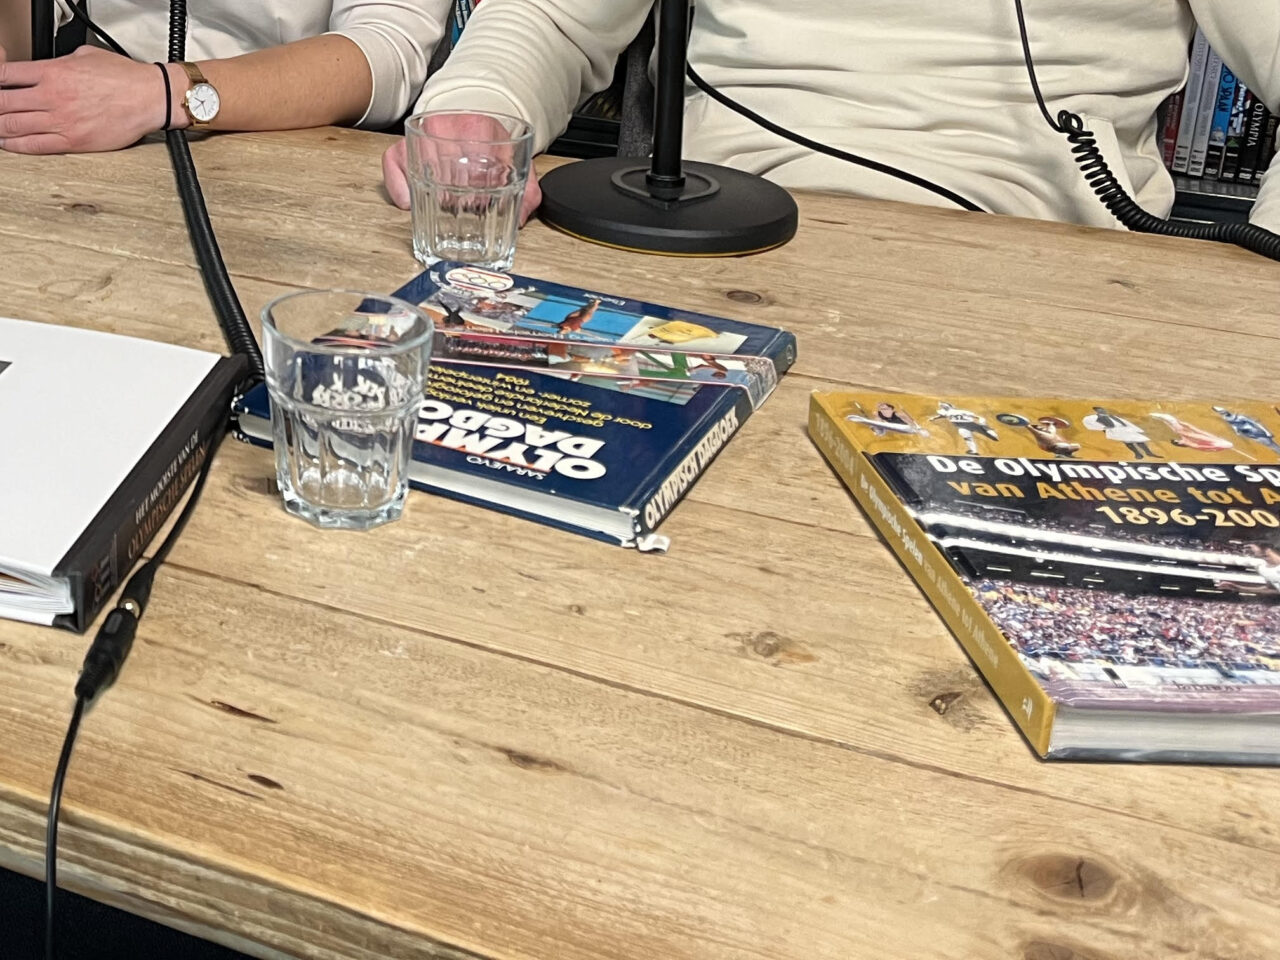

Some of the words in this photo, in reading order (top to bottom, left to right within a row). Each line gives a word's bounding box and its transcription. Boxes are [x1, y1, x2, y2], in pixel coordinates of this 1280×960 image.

[1247, 102, 1265, 146] OLYMPIA
[495, 372, 531, 386] 1984
[476, 401, 517, 418] uniek
[493, 388, 590, 417] Nederlandse
[494, 397, 515, 408] en
[516, 402, 605, 428] geschreven
[519, 413, 548, 425] Een
[590, 412, 614, 423] de
[615, 417, 653, 430] door
[467, 455, 547, 480] SARAJEVO
[644, 456, 700, 529] OLYMPISCH
[699, 405, 740, 468] DAGBOEK
[947, 480, 1023, 498] van
[1037, 481, 1179, 505] Athene
[1189, 487, 1252, 506] tot
[1096, 505, 1280, 528] 1896-200
